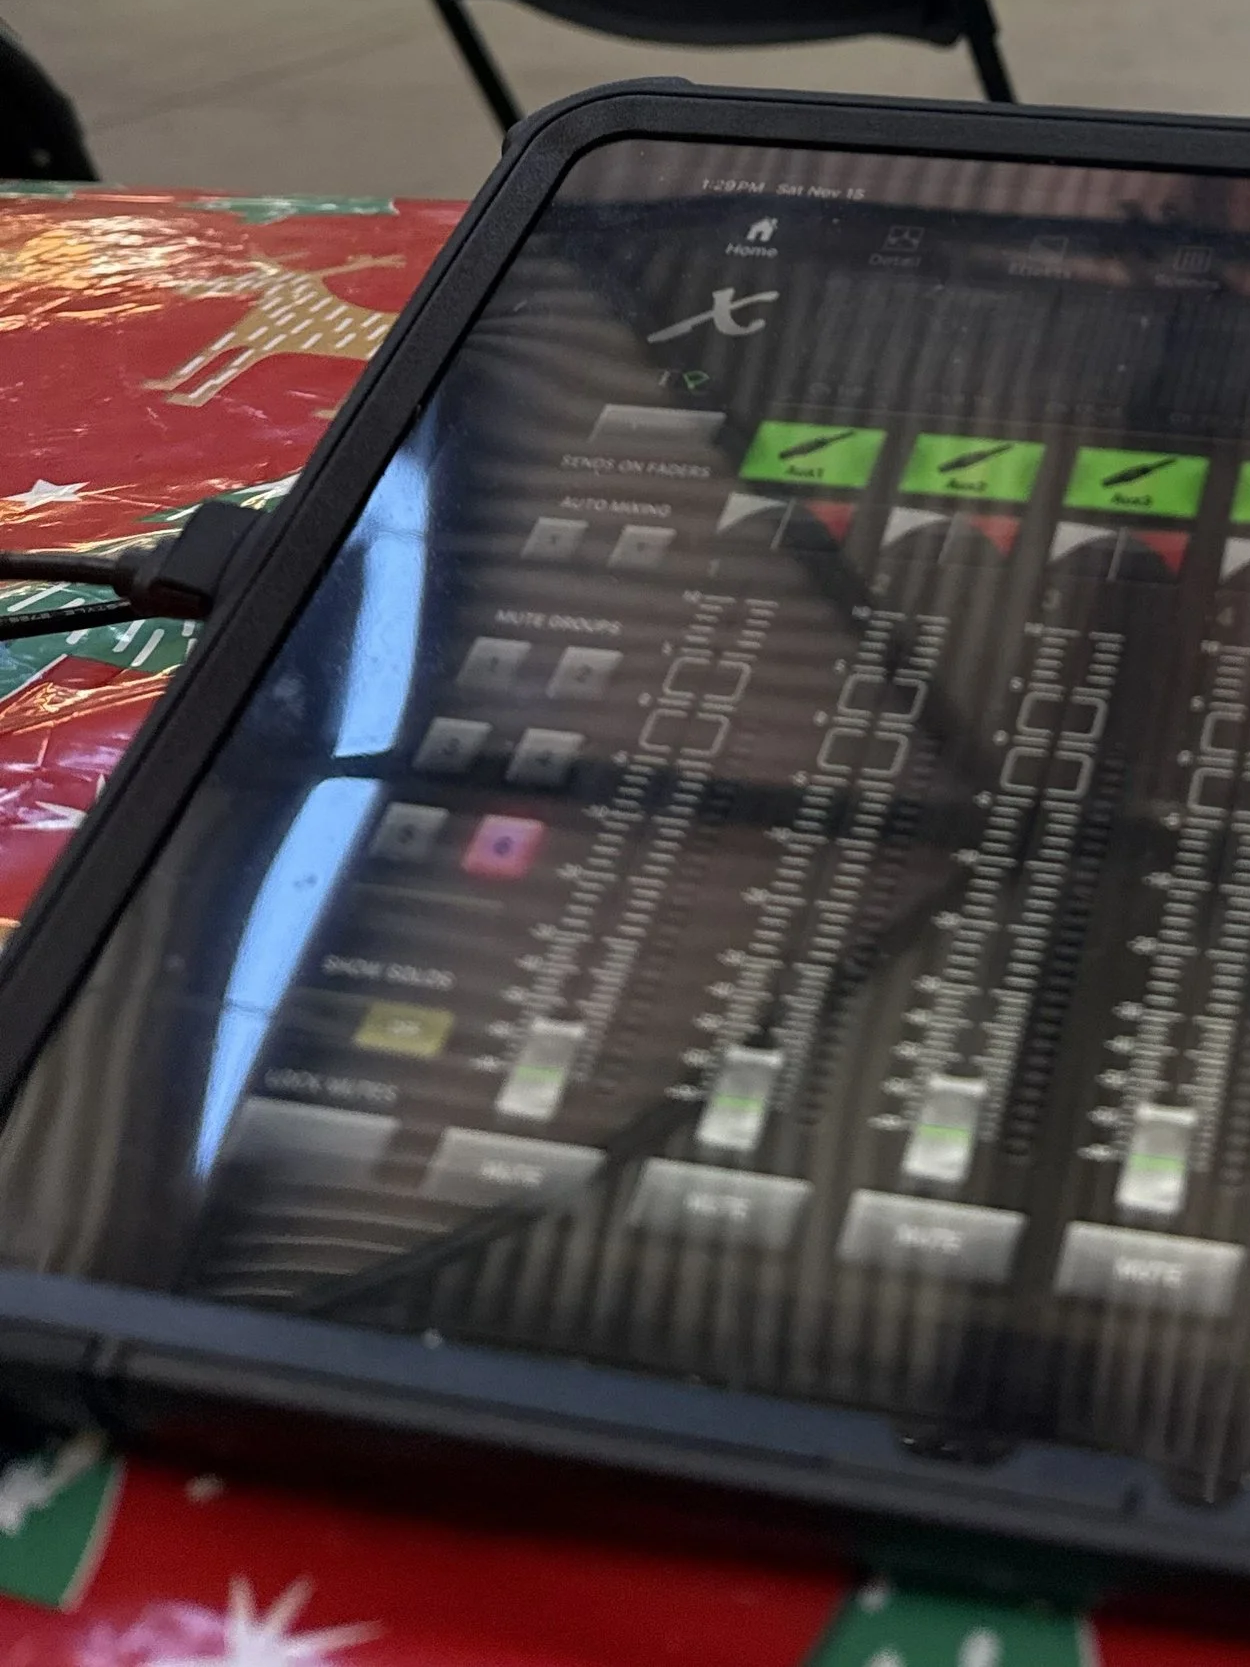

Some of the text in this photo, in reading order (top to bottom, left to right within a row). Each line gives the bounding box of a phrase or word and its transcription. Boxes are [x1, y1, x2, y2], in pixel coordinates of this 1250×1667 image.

[776, 183, 804, 195] Sat
[807, 185, 841, 199] Nov
[725, 243, 779, 259] Home
